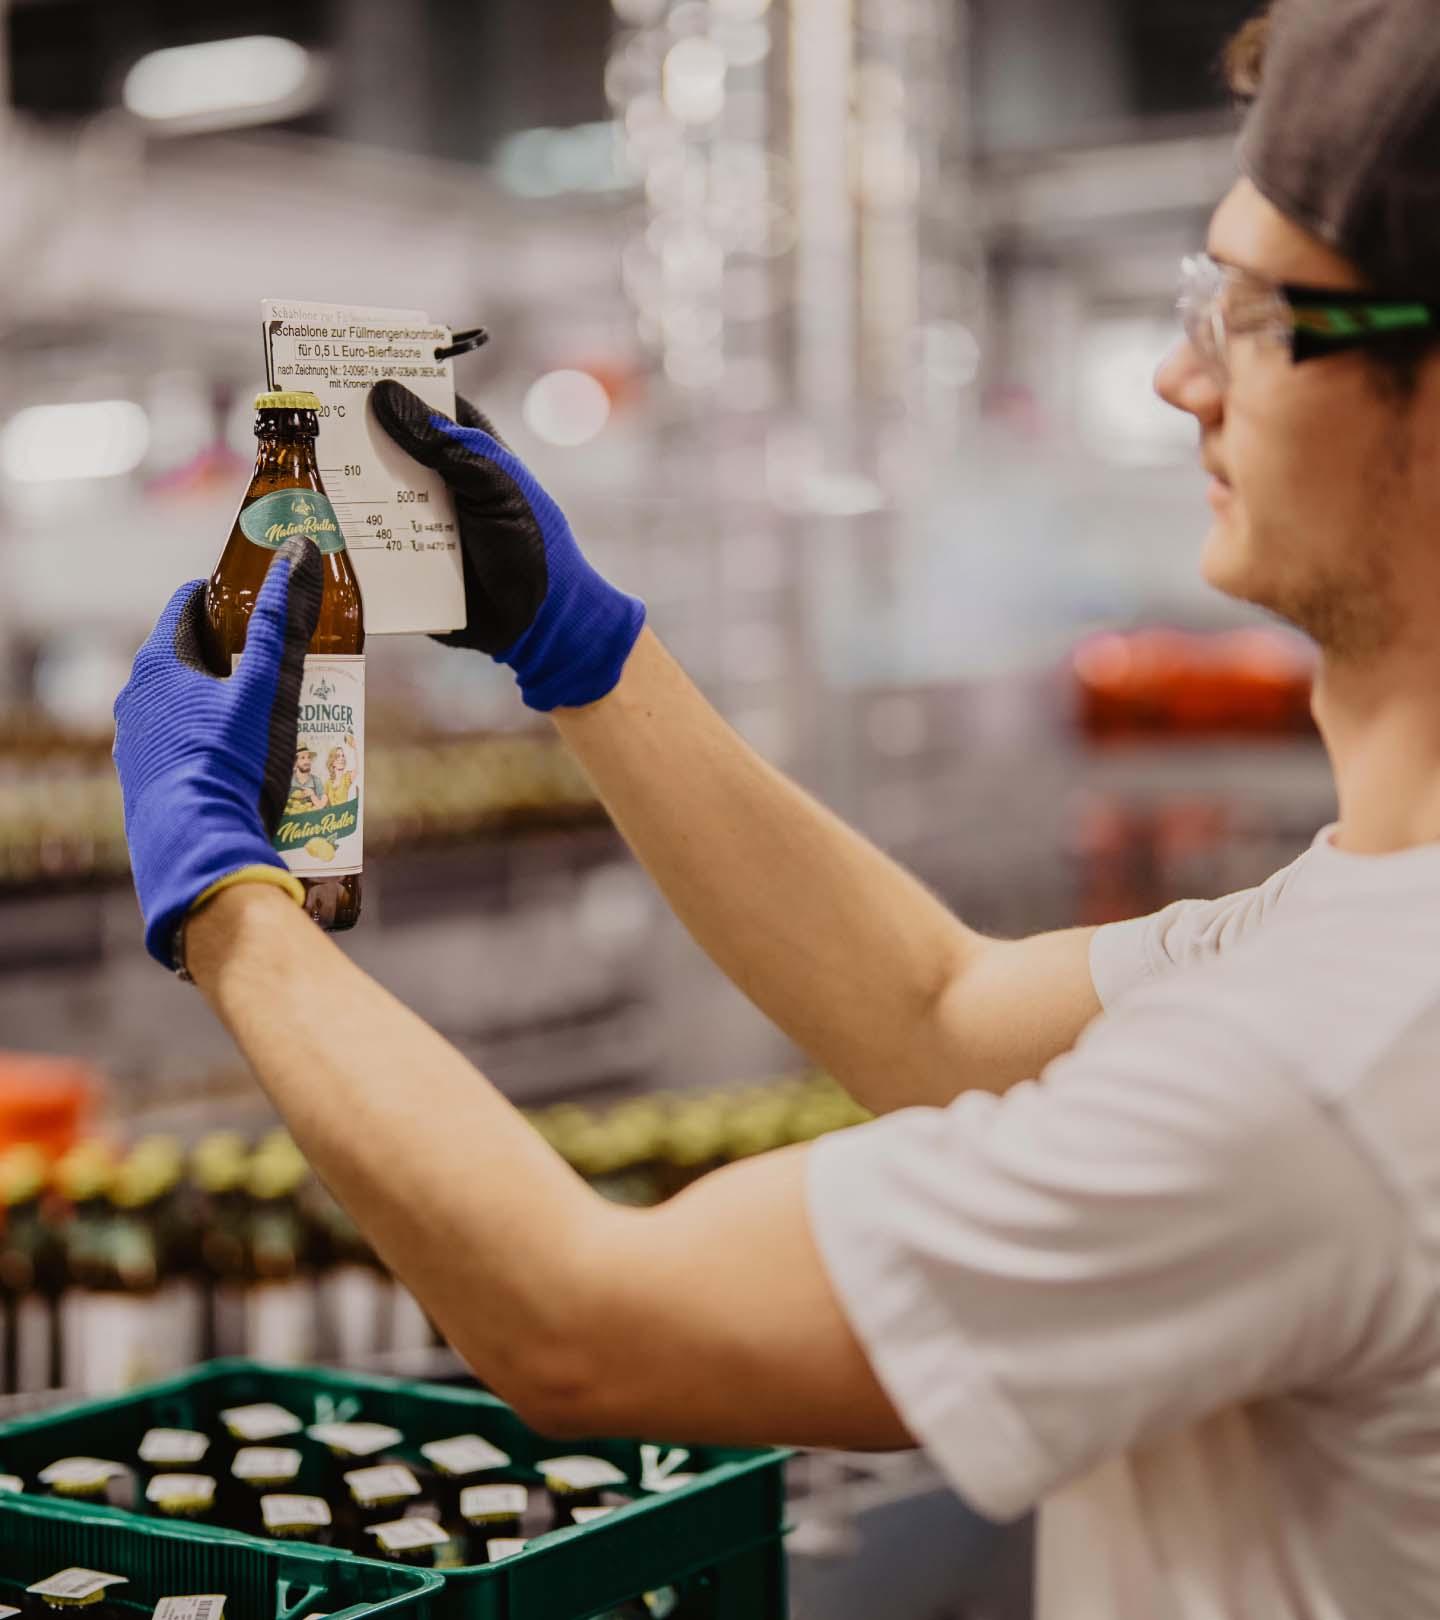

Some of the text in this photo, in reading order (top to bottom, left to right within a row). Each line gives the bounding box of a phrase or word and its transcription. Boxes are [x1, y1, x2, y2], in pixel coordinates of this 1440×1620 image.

[275, 324, 445, 342] Schablone zur Füllmengenkontrolle
[298, 344, 421, 359] für 0,5 L Euro-Bierflasche
[277, 365, 294, 375] nach
[295, 364, 329, 378] Zeichnung
[329, 380, 341, 389] mit
[318, 405, 346, 418] 20 °C
[344, 465, 361, 476] 510
[397, 490, 429, 503] 500 ml
[366, 515, 383, 526] 490
[375, 529, 392, 540] 480
[386, 540, 402, 551] 470
[297, 704, 353, 725] RDINGER
[297, 722, 346, 733] BRAUHAUS
